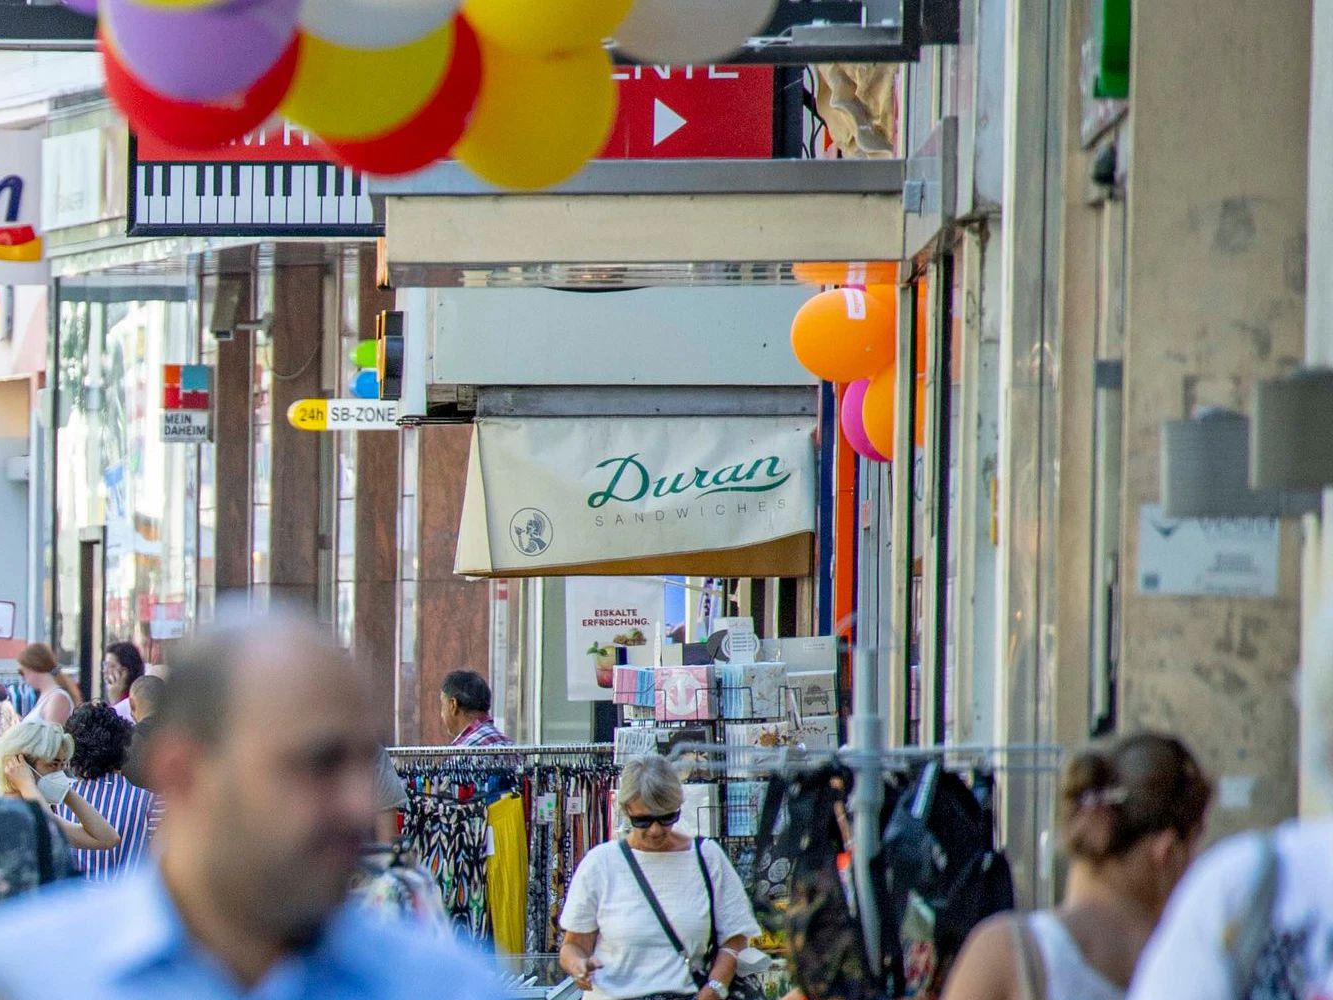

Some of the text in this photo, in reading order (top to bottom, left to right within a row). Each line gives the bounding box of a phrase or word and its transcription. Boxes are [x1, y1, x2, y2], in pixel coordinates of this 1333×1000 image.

[164, 413, 192, 424] MEIN
[299, 406, 396, 423] 24h SB-ZONE
[164, 425, 206, 436] DAHEIM
[587, 452, 791, 509] Duran
[594, 498, 787, 527] SANDWICHES
[594, 608, 638, 617] EISKALTE
[582, 617, 651, 627] ERFRISCHUNG.
